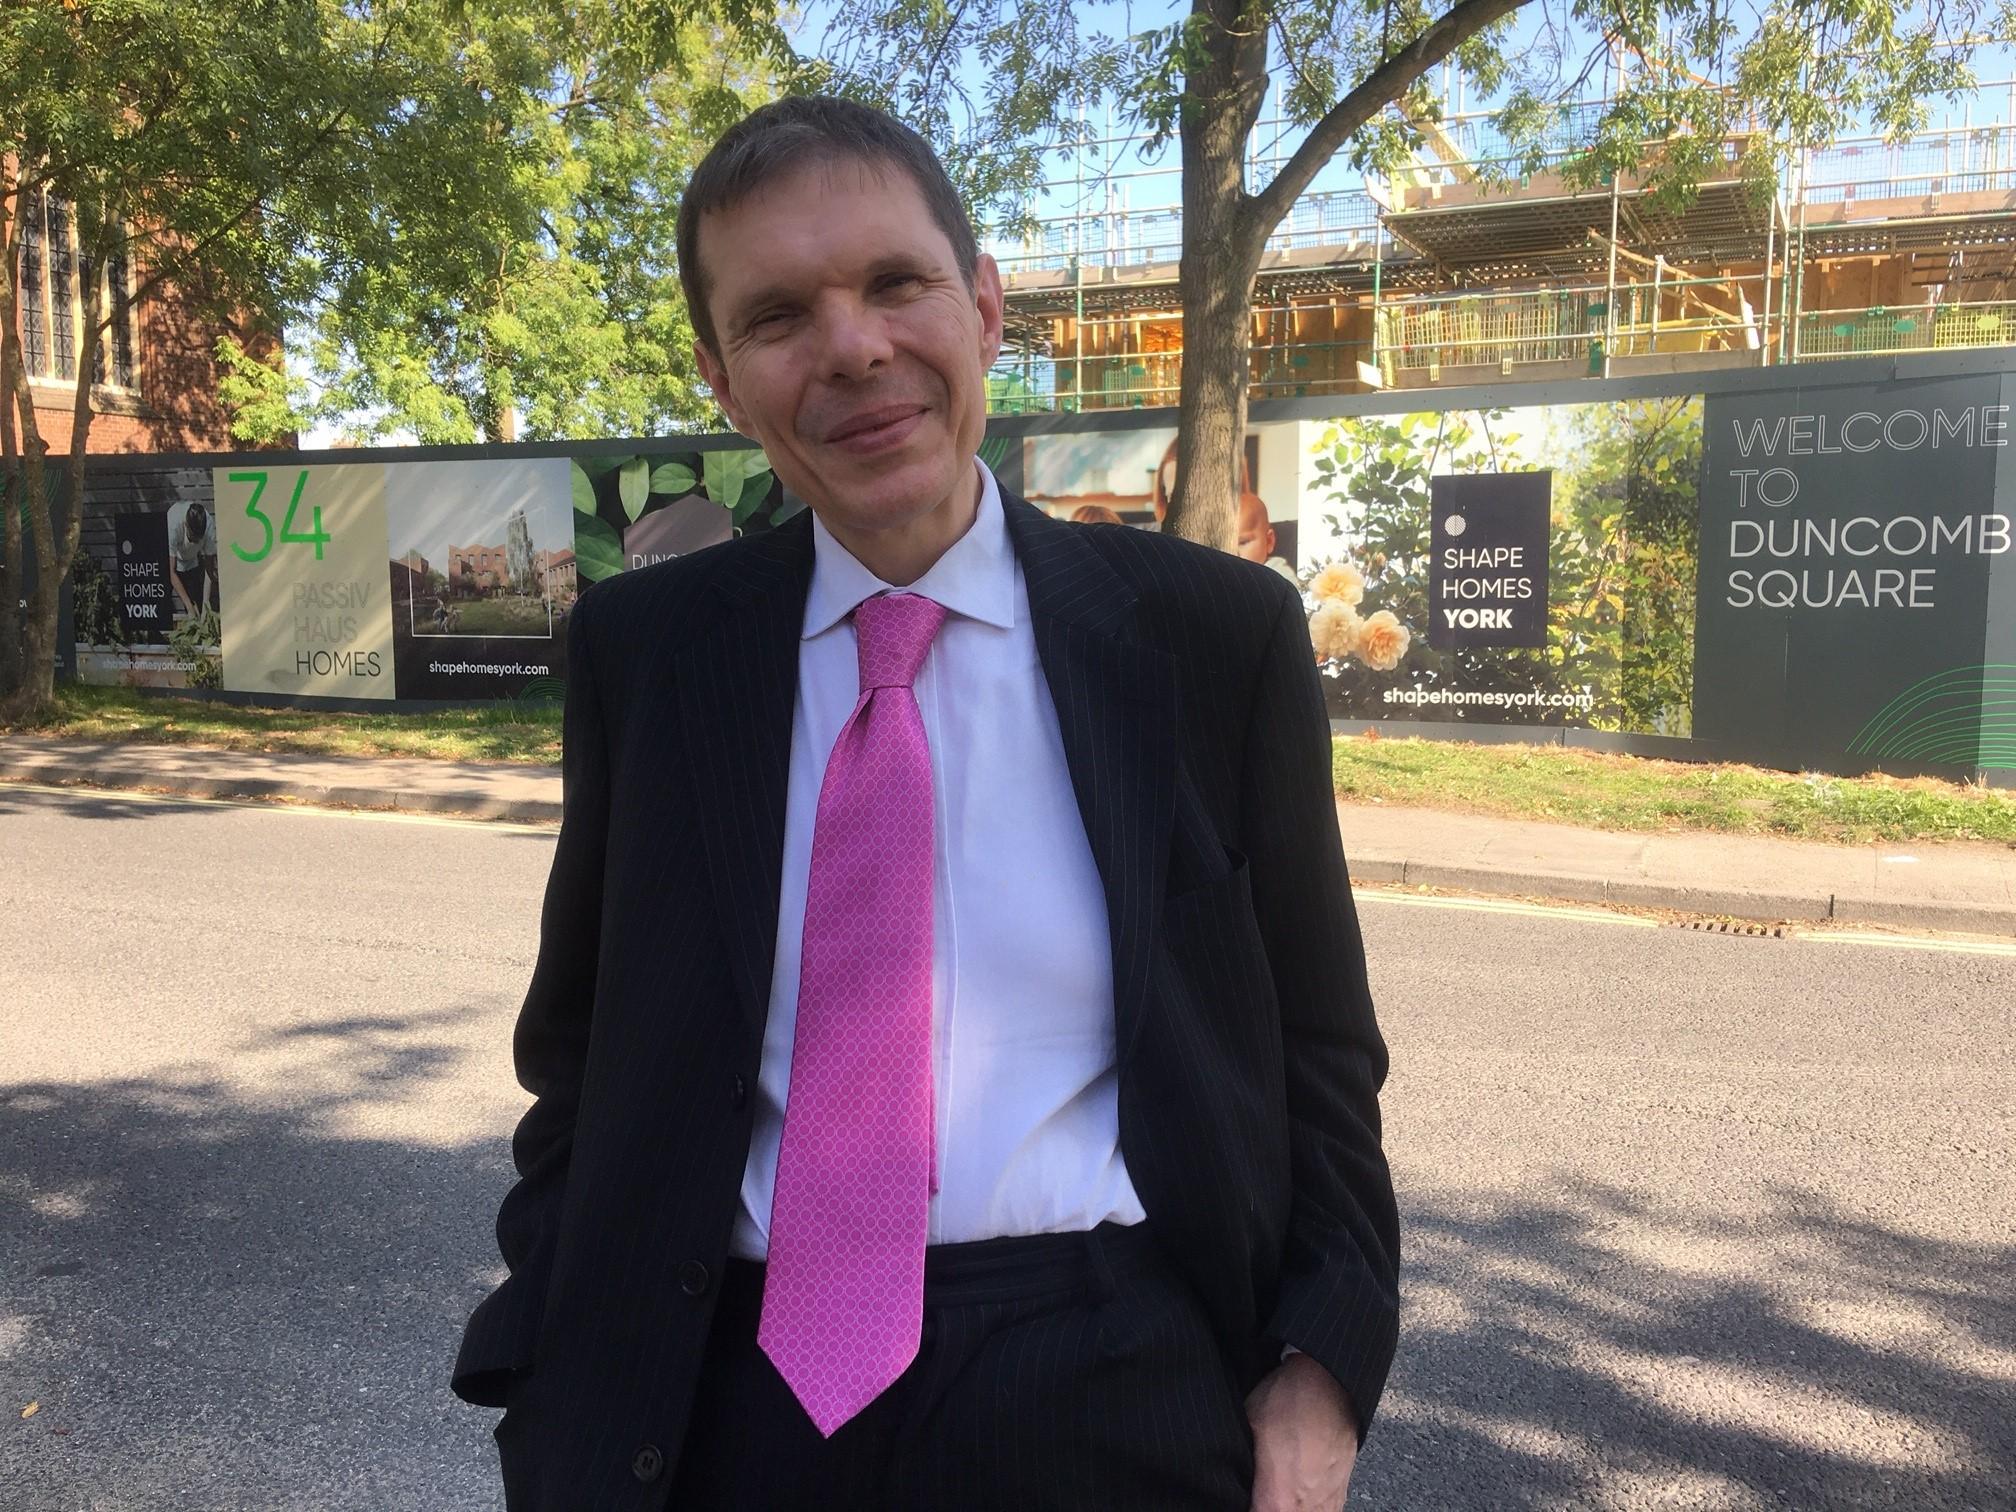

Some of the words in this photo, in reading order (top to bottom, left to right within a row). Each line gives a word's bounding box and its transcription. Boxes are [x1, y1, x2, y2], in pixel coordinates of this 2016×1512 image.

[1733, 405, 2010, 457] WELCOME
[1729, 467, 1799, 507] TO
[228, 470, 331, 562] 34
[1729, 514, 2012, 557] DUNCOMB
[123, 562, 160, 578] SHAPE
[1443, 547, 1524, 569] SHAPE
[124, 583, 165, 598] HOMES
[292, 581, 371, 609] PASSIV
[1442, 578, 1533, 599] HOMES
[1726, 569, 1936, 608] SQUARE
[126, 604, 158, 618] YORK
[1443, 608, 1513, 629] YORK
[294, 616, 358, 643] HAUS
[296, 650, 381, 677] HOMES
[429, 661, 549, 676] shapehomesyork.com
[1383, 687, 1594, 708] shapehomesyork.com
